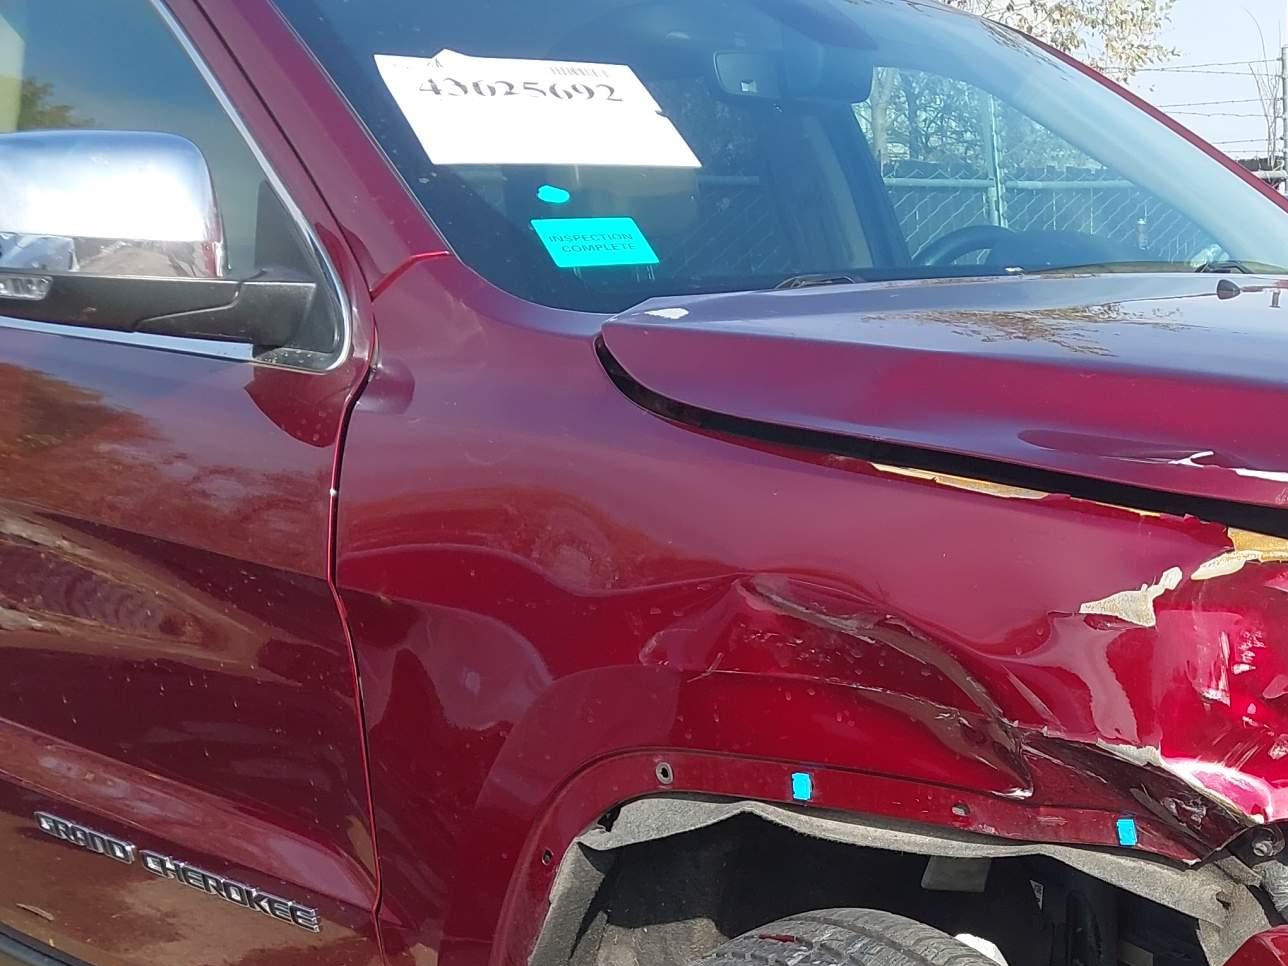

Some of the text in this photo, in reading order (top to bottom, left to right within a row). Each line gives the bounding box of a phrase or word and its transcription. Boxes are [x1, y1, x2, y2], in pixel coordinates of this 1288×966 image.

[548, 232, 633, 243] INSPECTION
[561, 243, 637, 253] COMPLETE
[33, 811, 321, 934] GRAND CHEROKEE
